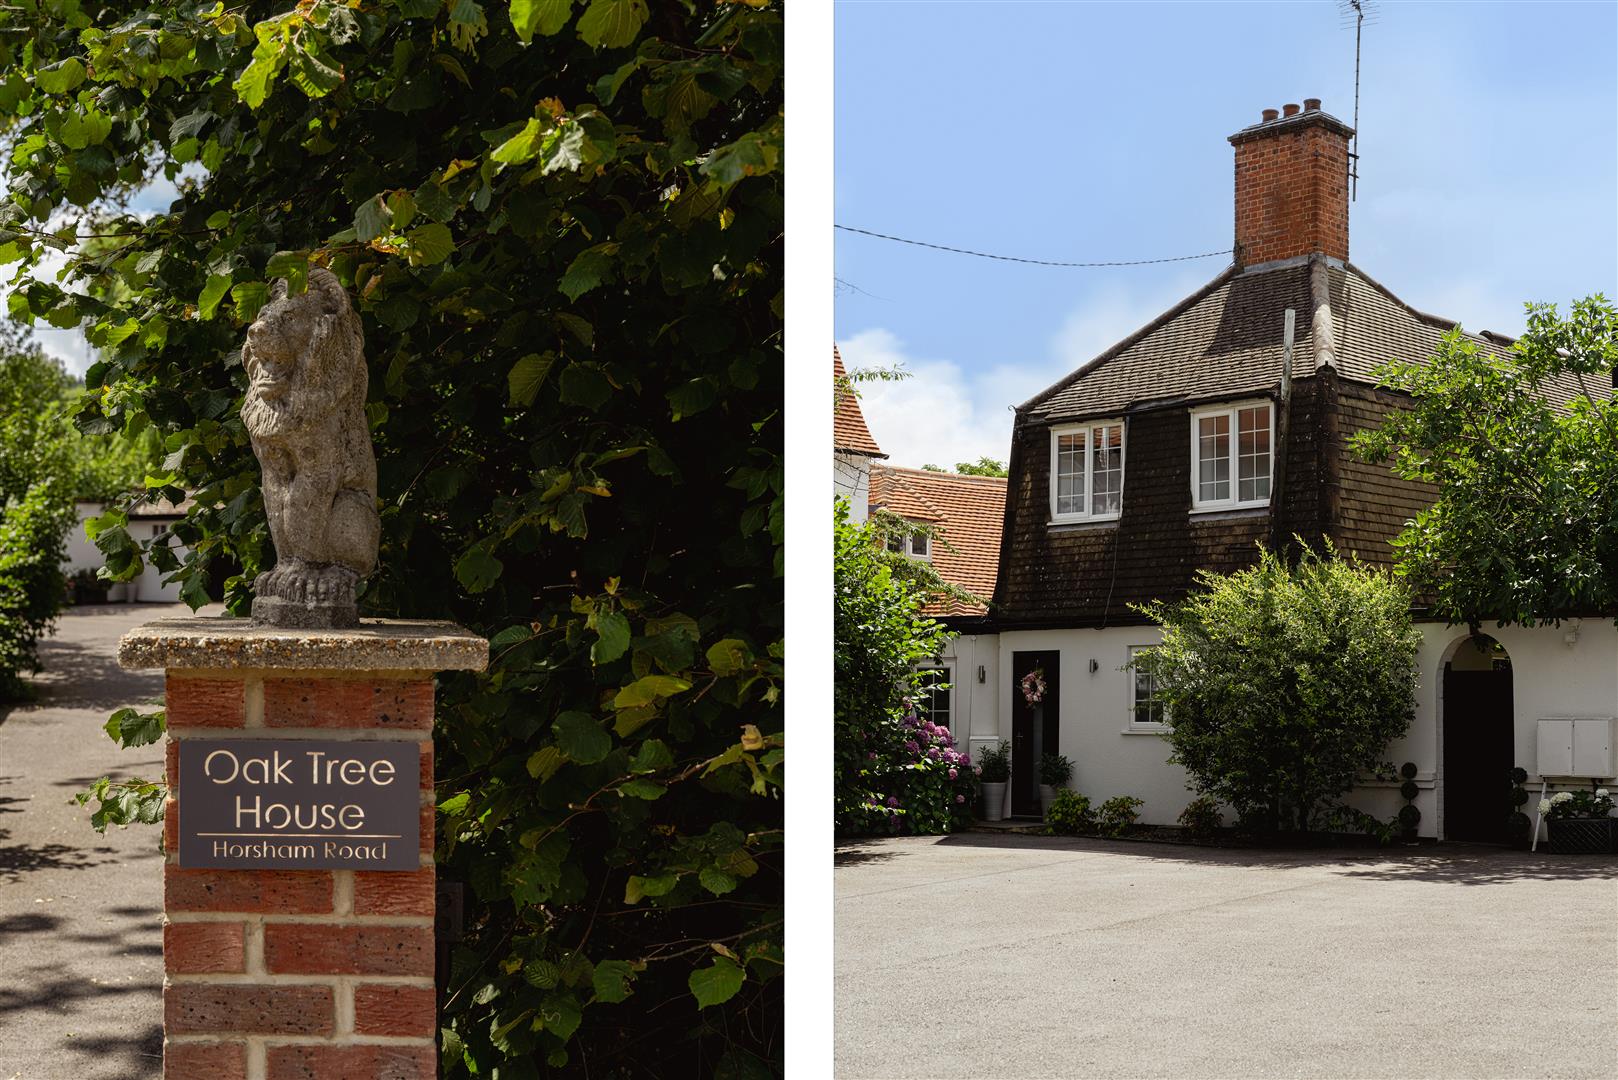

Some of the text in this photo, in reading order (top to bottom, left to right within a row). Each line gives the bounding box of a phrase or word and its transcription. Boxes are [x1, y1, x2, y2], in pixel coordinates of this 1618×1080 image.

[204, 750, 396, 786] Oak Tree
[236, 795, 366, 830] House
[213, 840, 387, 860] Horsham Road
